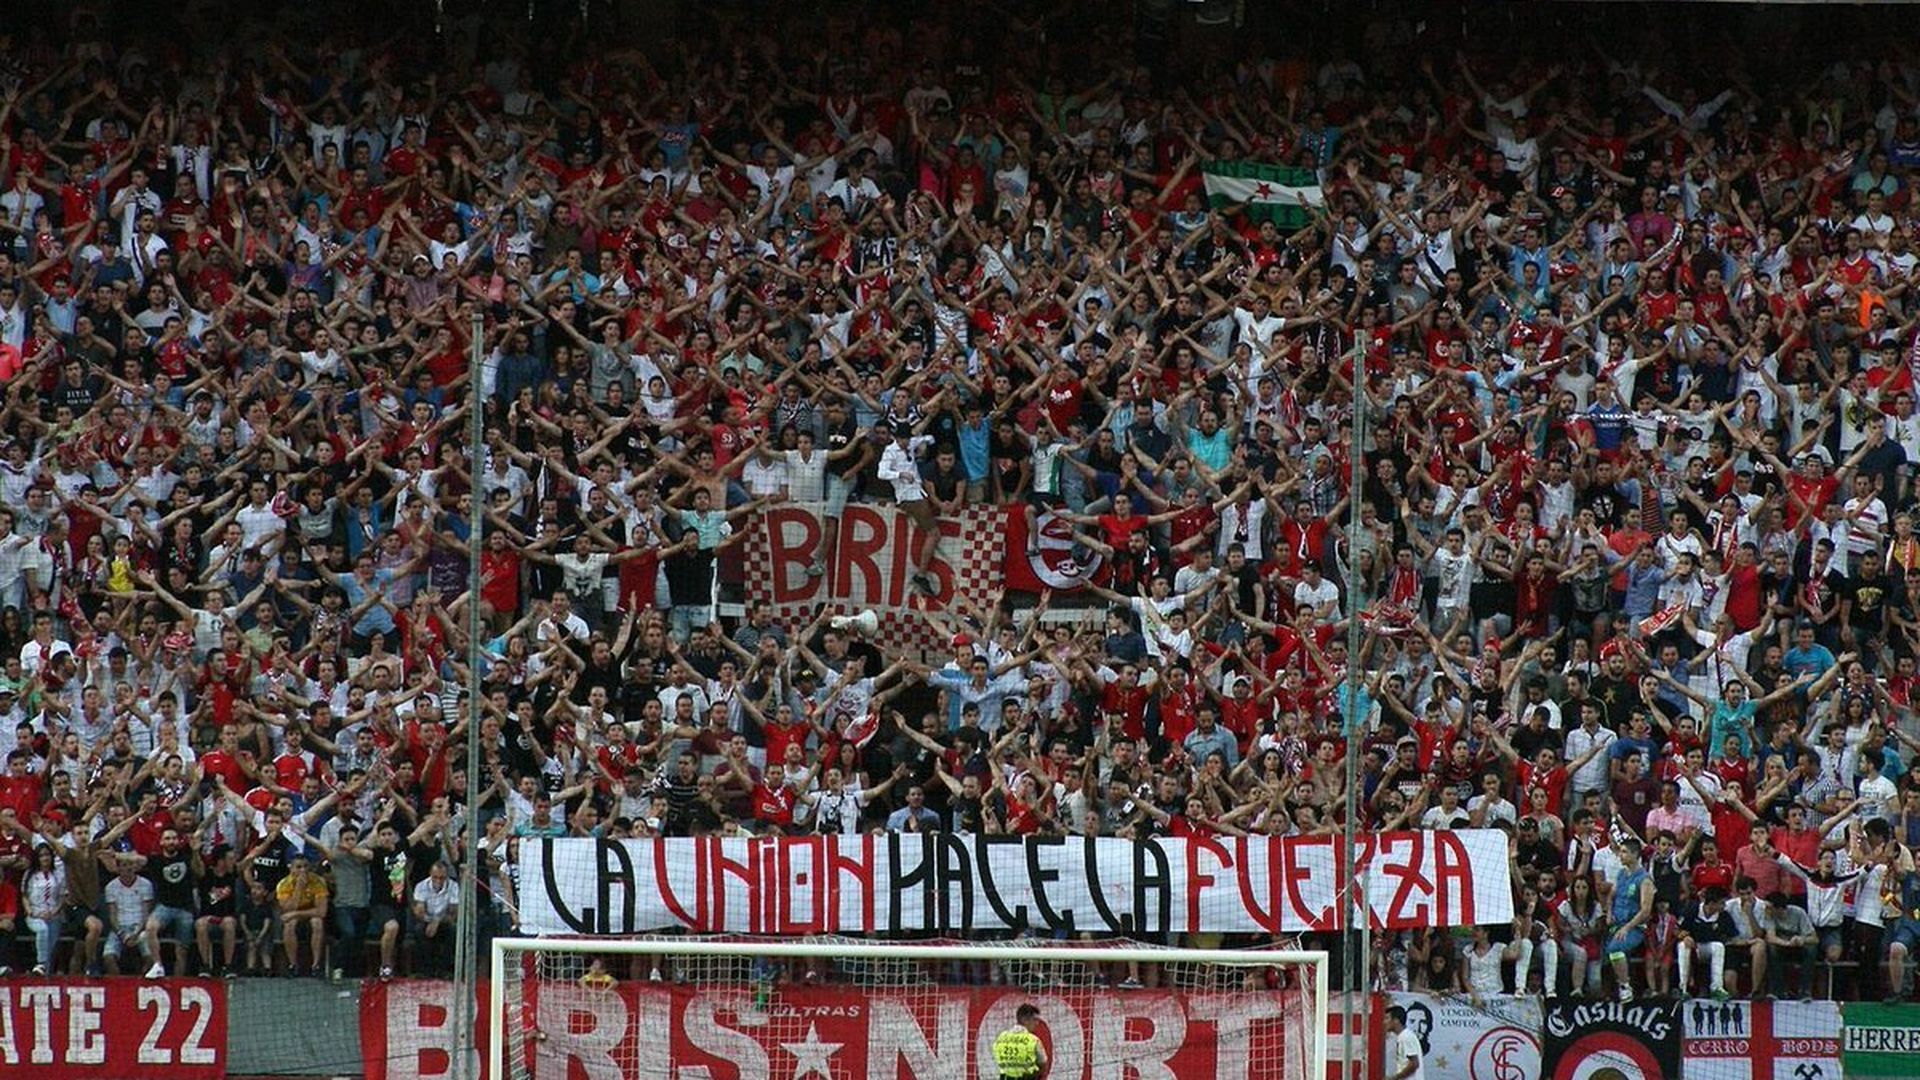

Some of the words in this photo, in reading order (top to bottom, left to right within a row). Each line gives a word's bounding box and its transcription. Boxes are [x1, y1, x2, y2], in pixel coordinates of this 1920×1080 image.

[542, 837, 635, 934] LA
[888, 832, 1073, 934] HACE
[1084, 835, 1171, 933] LA
[1186, 829, 1476, 933] FUERZA
[138, 986, 216, 1064] 22
[773, 1005, 860, 1017] ULTRAS
[1548, 1001, 1671, 1040] Casuals
[1688, 1040, 1749, 1055] CERRO
[1849, 1028, 1920, 1051] HERRE
